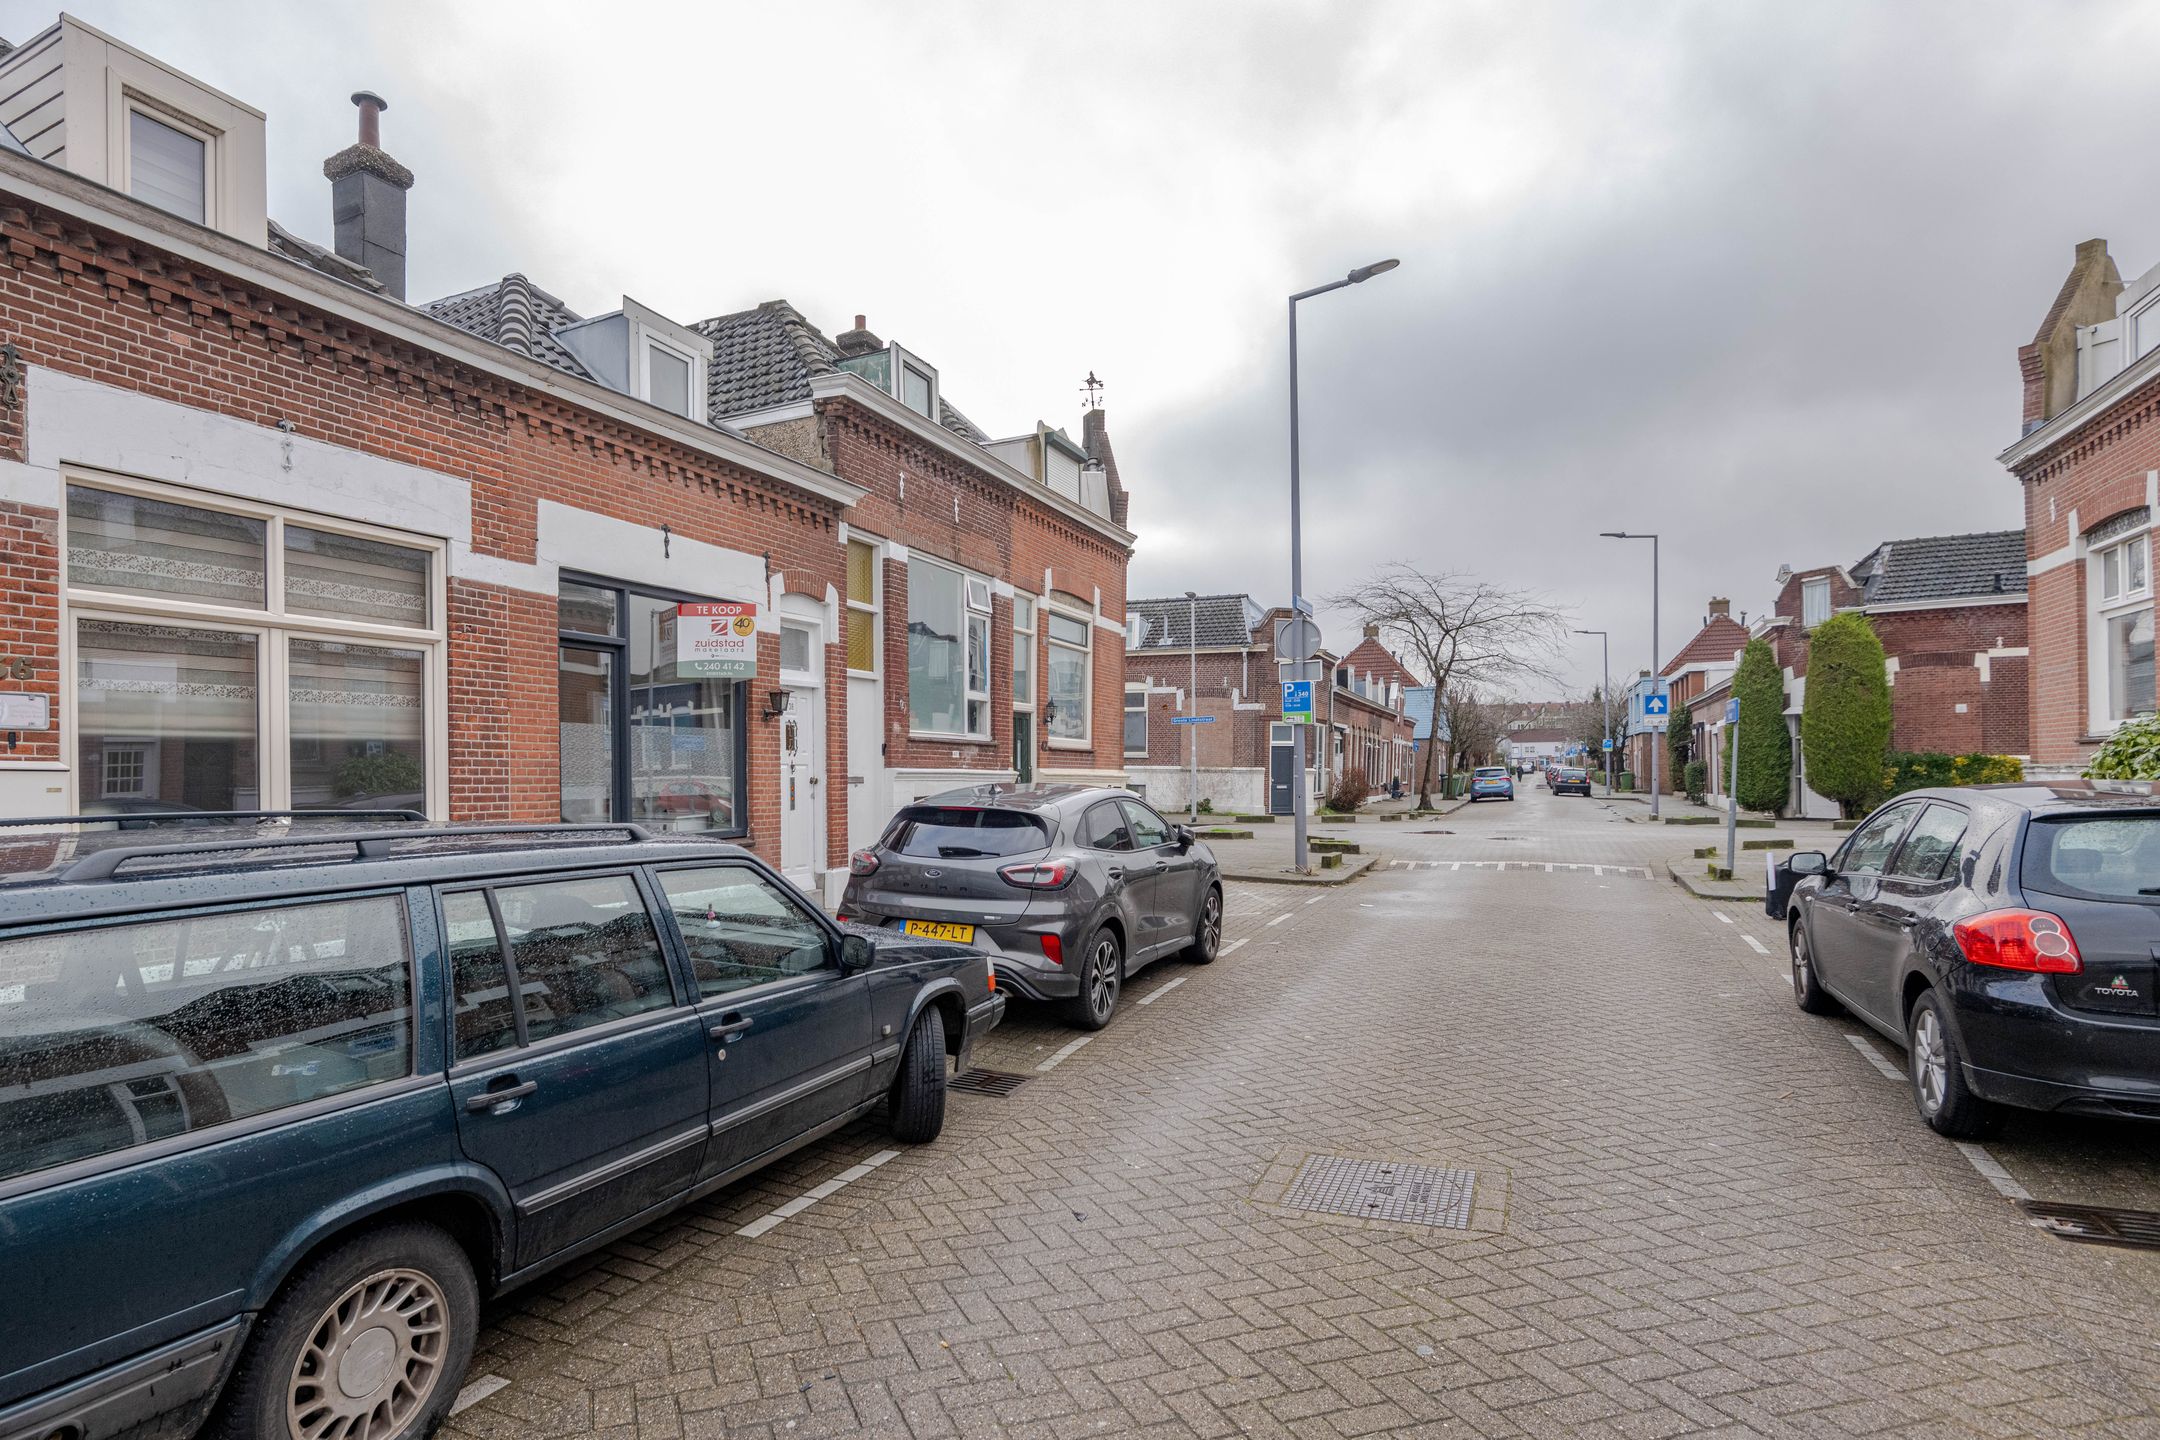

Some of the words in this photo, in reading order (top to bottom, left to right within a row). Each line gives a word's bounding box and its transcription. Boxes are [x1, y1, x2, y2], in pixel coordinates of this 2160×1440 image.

[697, 606, 708, 614] TE
[712, 606, 742, 614] KOOP
[695, 639, 744, 647] zuidstad
[703, 662, 720, 670] 240
[722, 662, 732, 670] 41
[734, 662, 745, 671] 42
[1284, 683, 1295, 697] P
[910, 922, 967, 940] P-447-LT
[2094, 988, 2138, 997] TOYOTA
